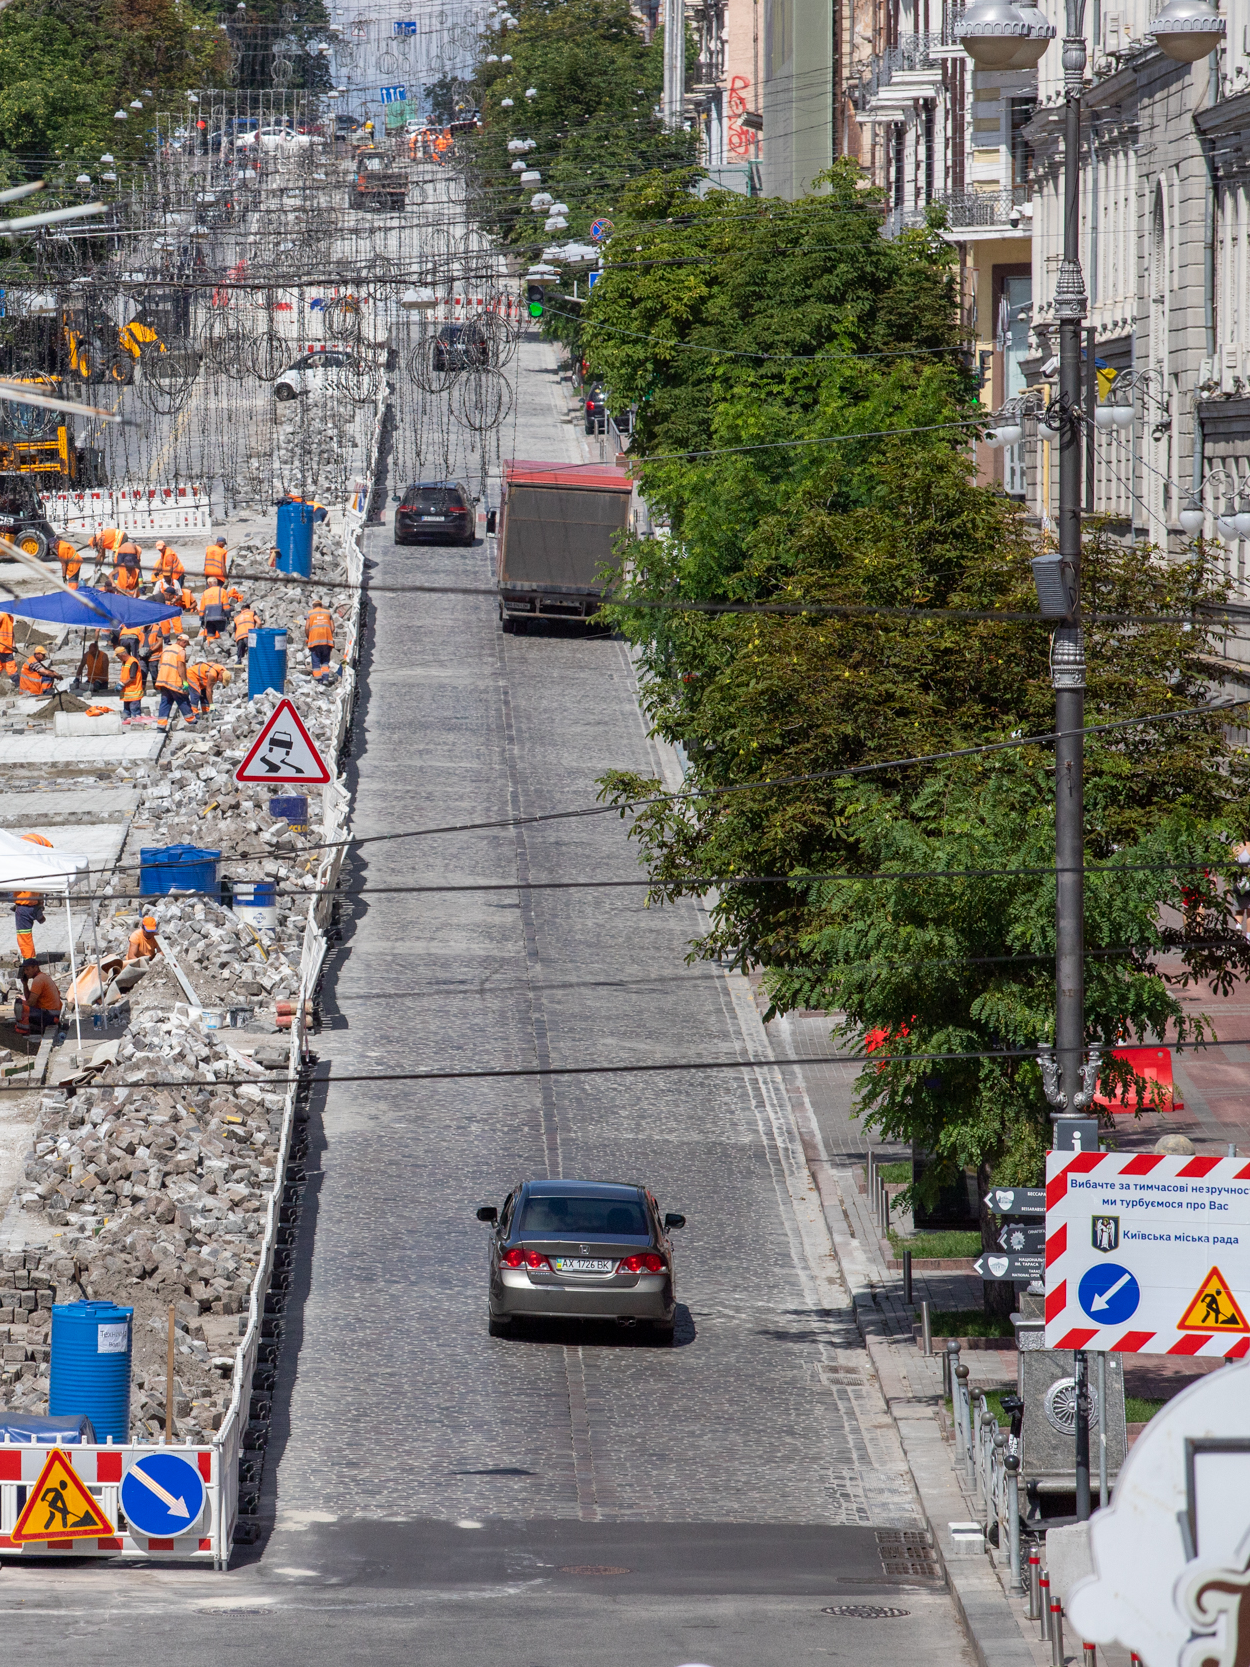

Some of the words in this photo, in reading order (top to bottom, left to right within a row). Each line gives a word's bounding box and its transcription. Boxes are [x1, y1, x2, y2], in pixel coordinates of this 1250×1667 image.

[1070, 1178, 1116, 1190] Вибачте
[1133, 1183, 1189, 1193] тимчасові
[1102, 1198, 1117, 1206] ми
[1120, 1198, 1184, 1210] турбуємося
[1186, 1202, 1206, 1212] про
[1208, 1201, 1229, 1211] Вас
[1123, 1229, 1172, 1242] Київська
[1174, 1232, 1210, 1243] міська
[1212, 1235, 1239, 1246] рада
[562, 1258, 574, 1268] AX
[577, 1259, 595, 1269] 1726
[597, 1260, 609, 1270] BK
